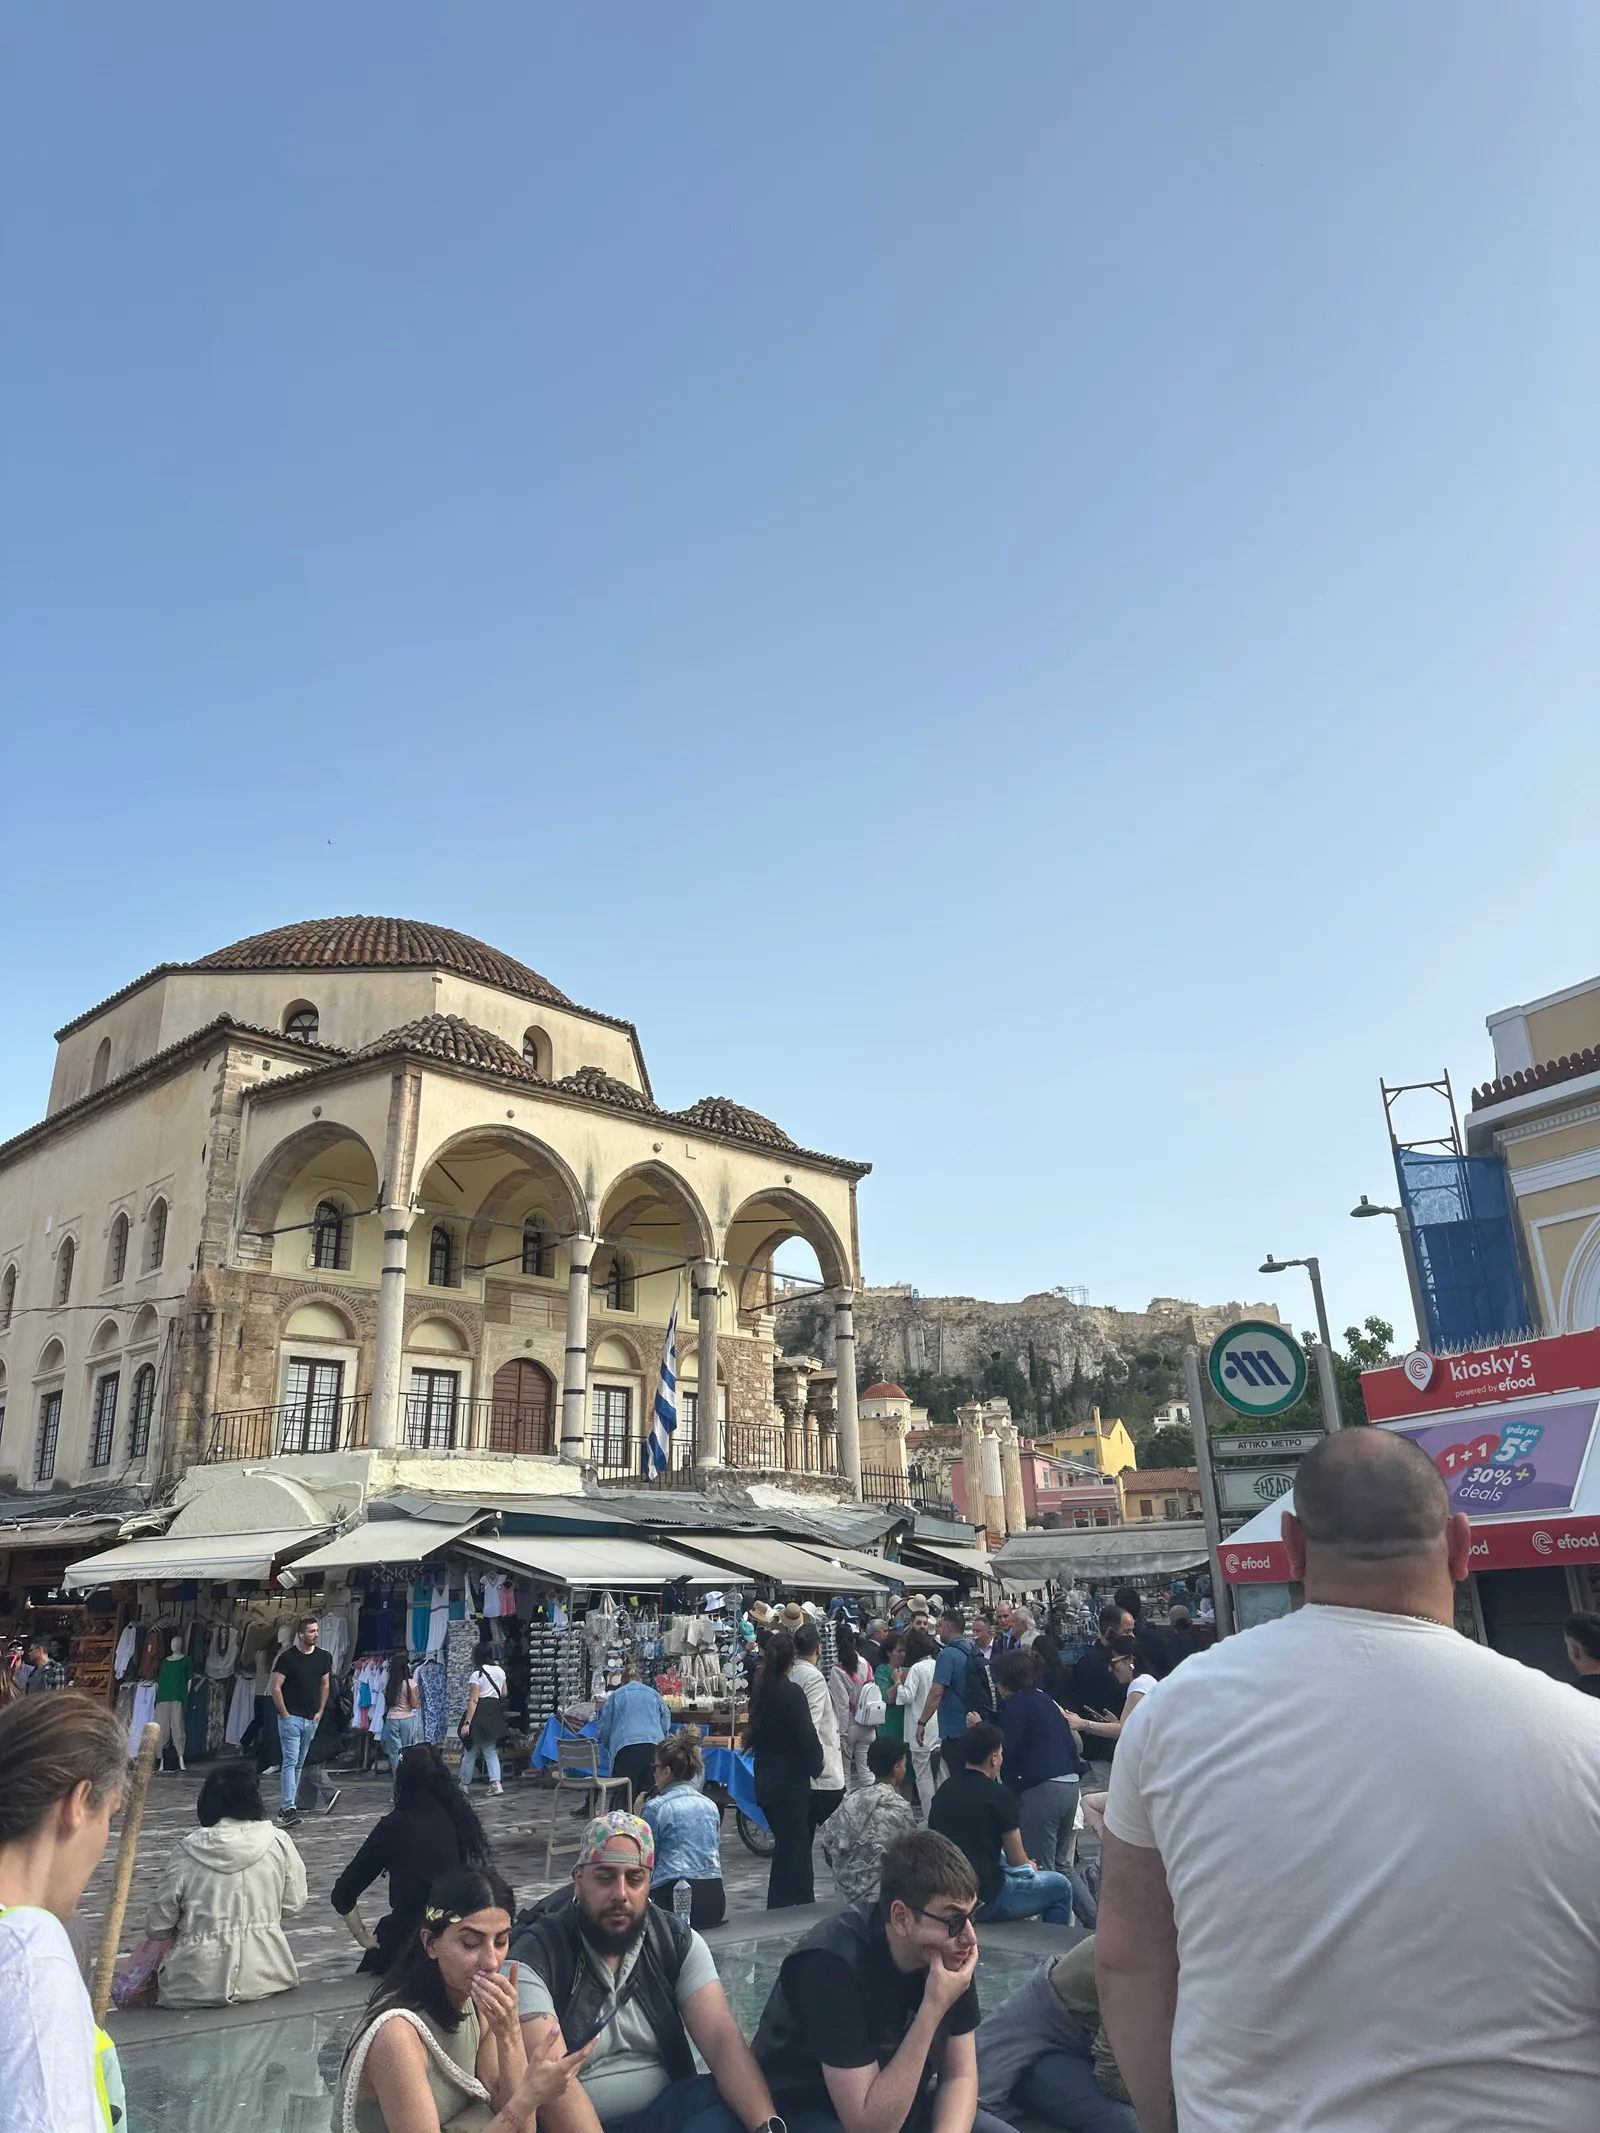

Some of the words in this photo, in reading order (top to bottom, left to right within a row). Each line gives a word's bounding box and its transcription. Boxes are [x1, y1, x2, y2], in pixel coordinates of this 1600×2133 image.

[1449, 1350, 1532, 1381] kiosky's
[1455, 1385, 1486, 1398] powered
[1488, 1384, 1498, 1393] by
[1498, 1372, 1536, 1392] efood
[1506, 1425, 1525, 1435] φάε
[1526, 1428, 1539, 1437] με
[1238, 1440, 1268, 1449] ΑΤΤΙΚΟ
[1271, 1439, 1302, 1447] ΜΕΤΡΟ
[1459, 1484, 1503, 1502] deals
[1557, 1531, 1600, 1549] efood
[1241, 1555, 1271, 1570] efood
